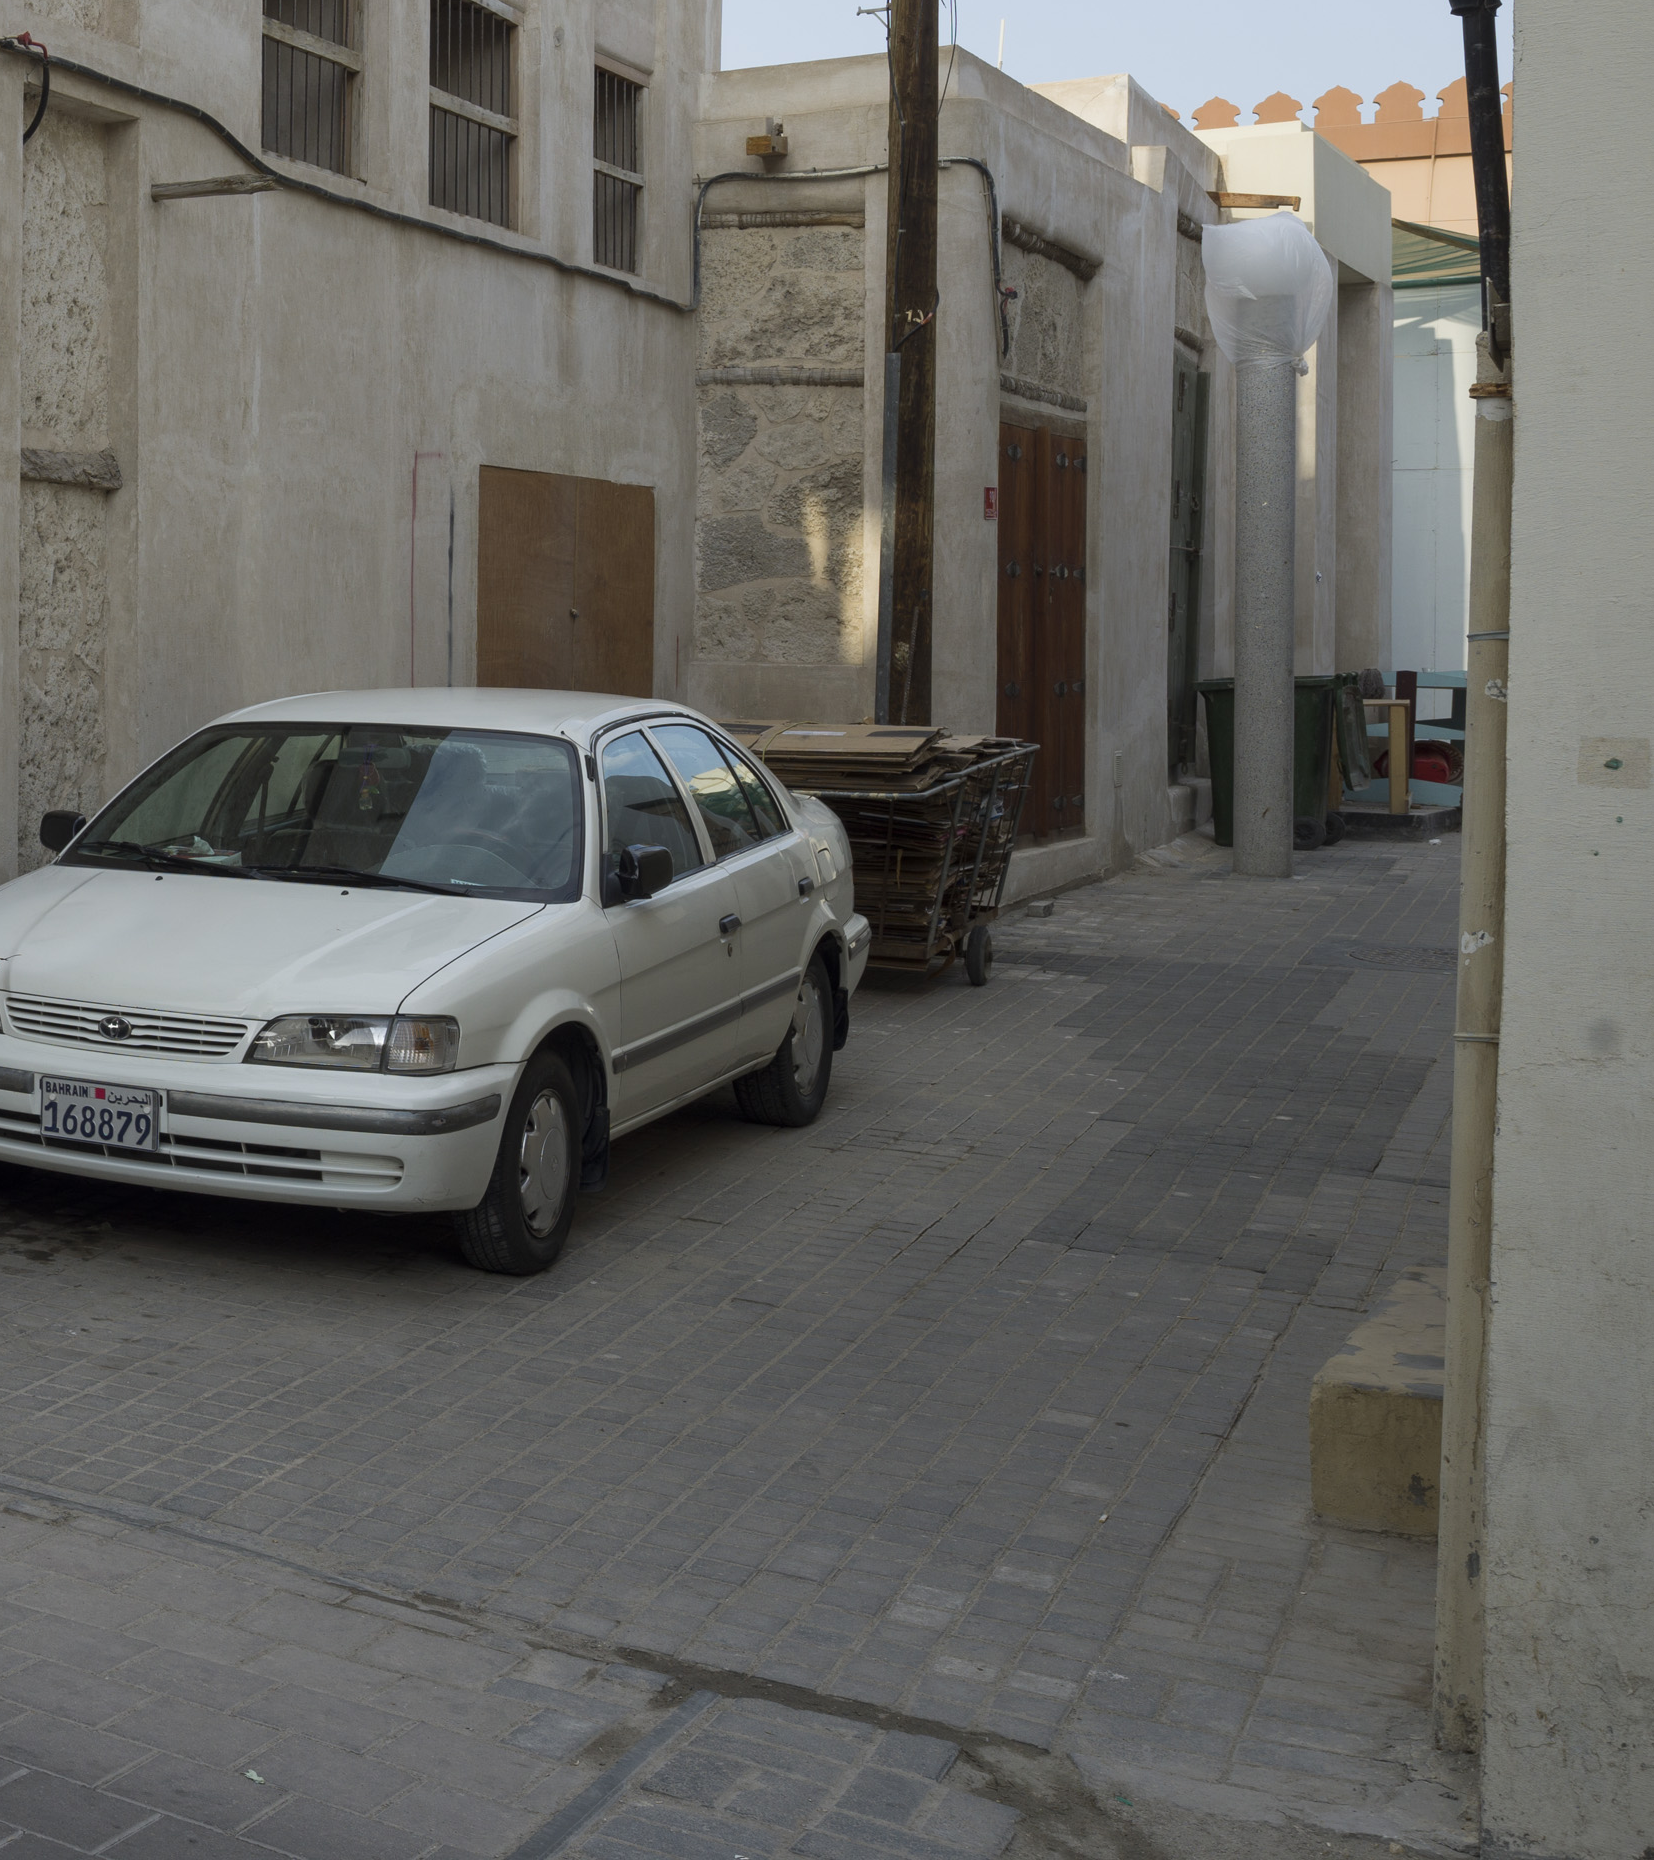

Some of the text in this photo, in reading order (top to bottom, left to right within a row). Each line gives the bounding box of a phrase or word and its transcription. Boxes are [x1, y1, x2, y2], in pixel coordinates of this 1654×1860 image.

[45, 1081, 89, 1098] BAHRAIN
[107, 1091, 152, 1108] البحرين
[44, 1101, 151, 1146] 168879
